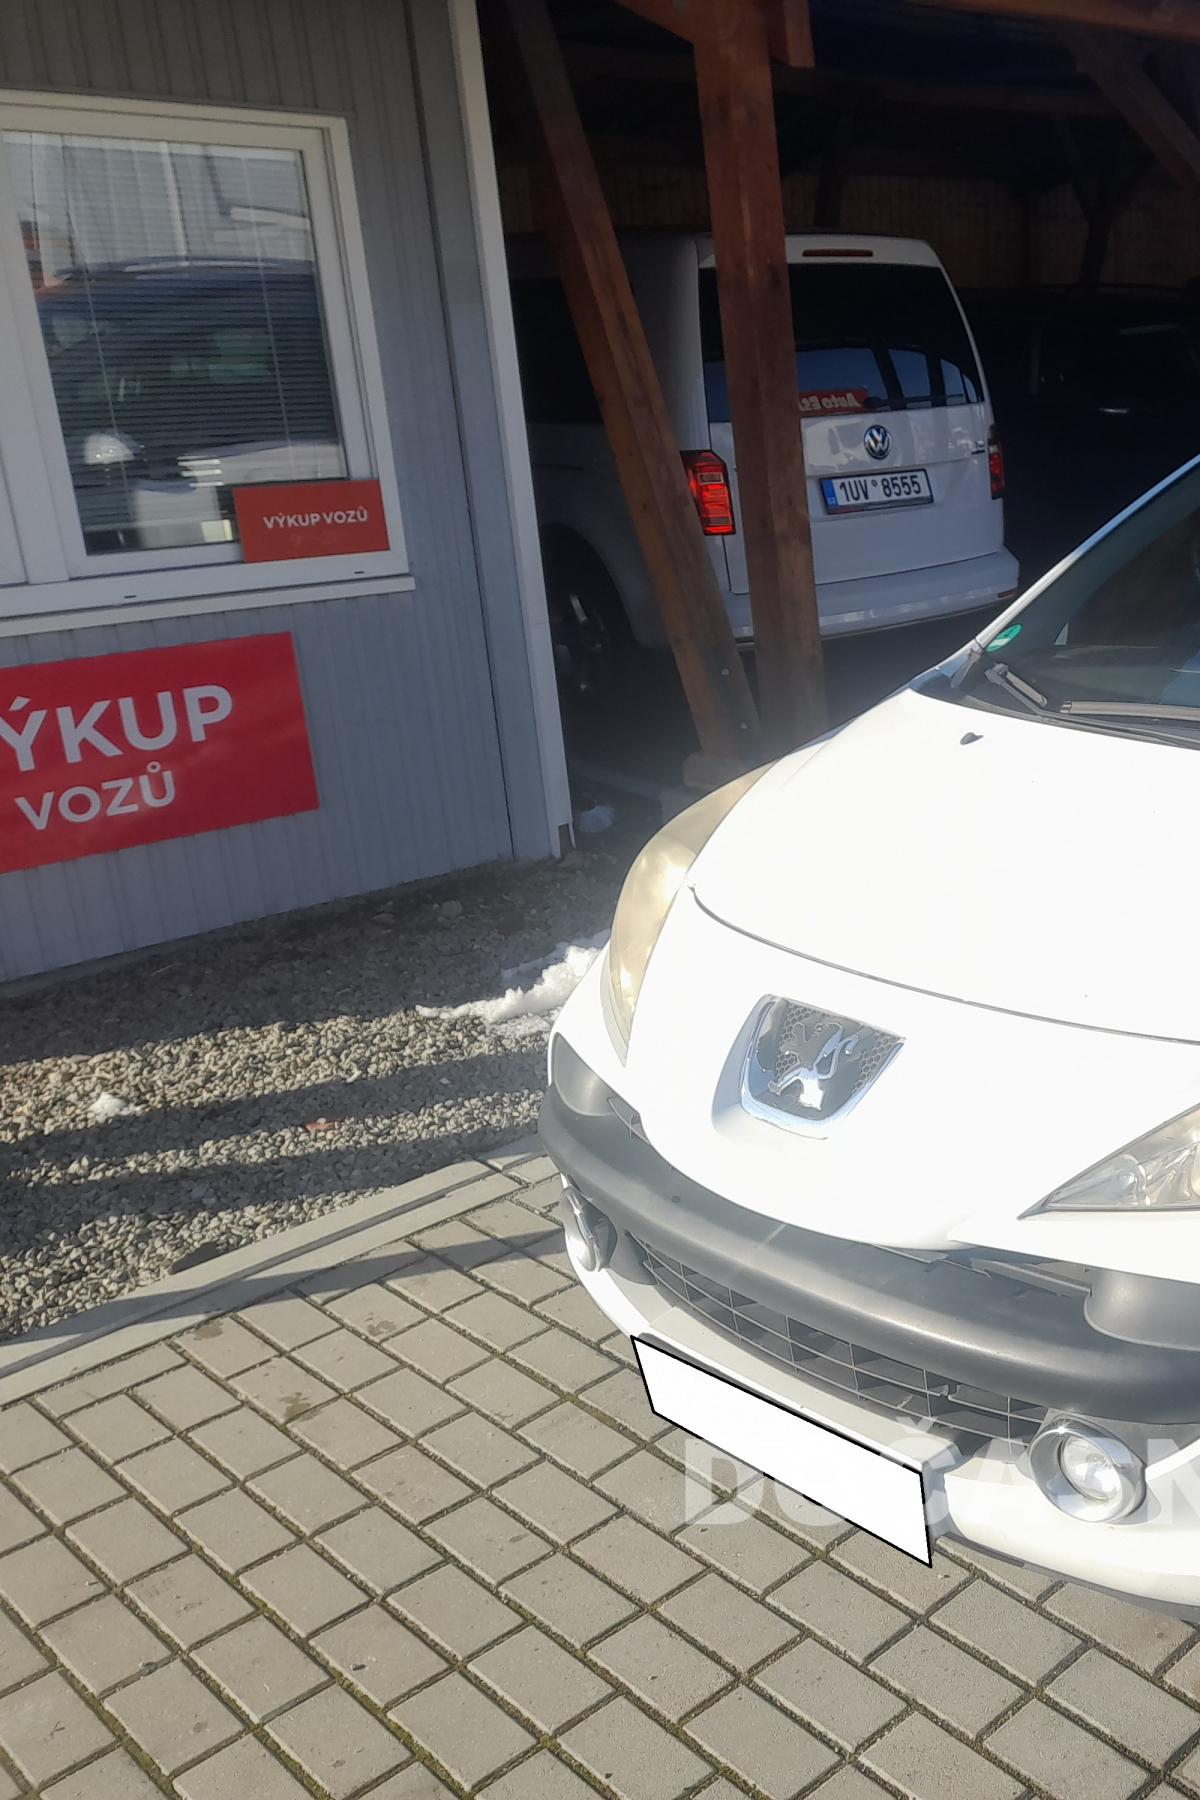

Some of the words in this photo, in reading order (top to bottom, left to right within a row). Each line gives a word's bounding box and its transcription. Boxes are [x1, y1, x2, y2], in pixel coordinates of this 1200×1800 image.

[839, 479, 870, 503] 1UV
[882, 474, 922, 497] 8555
[262, 512, 321, 530] VÝKUP
[322, 505, 369, 524] VOZŮ
[0, 684, 234, 773] ÝKUP
[14, 760, 176, 832] VOZŮ
